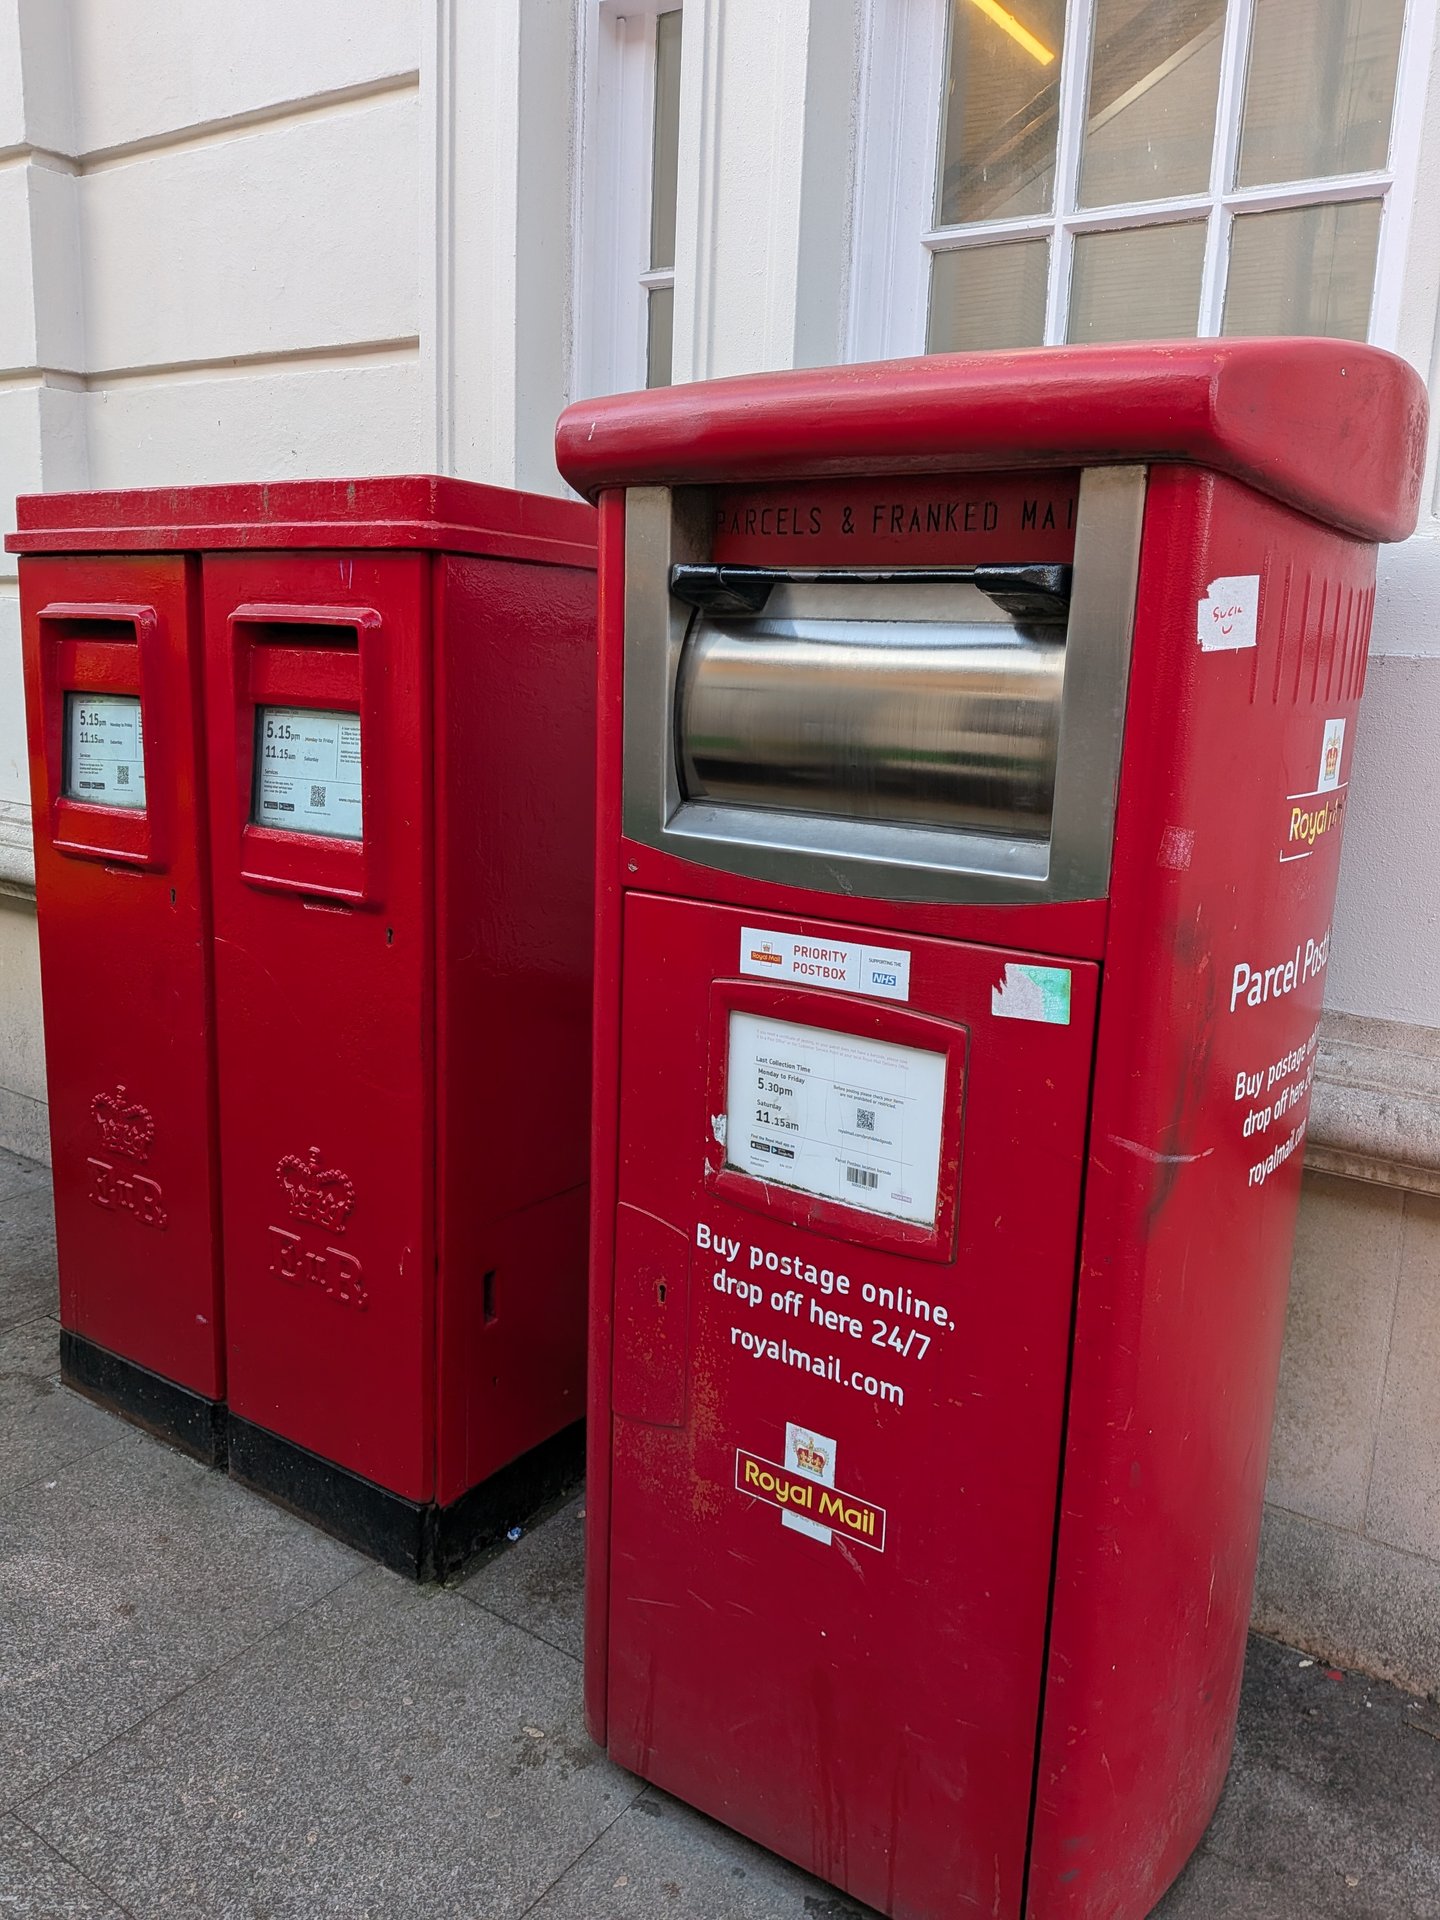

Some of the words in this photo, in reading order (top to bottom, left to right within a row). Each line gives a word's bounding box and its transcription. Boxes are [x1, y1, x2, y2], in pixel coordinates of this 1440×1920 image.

[716, 506, 822, 536] PARCELS
[840, 505, 856, 535] &
[872, 500, 999, 534] FRANKED
[80, 709, 106, 727] 5.15pm
[80, 732, 104, 744] 11.15am
[266, 720, 301, 741] 5.15pm
[265, 744, 296, 760] 11.15am
[793, 944, 847, 964] PRIORITY
[868, 957, 894, 967] SUPPORTING
[793, 961, 846, 981] POSTBOX
[873, 973, 896, 986] NHS
[1230, 944, 1301, 1013] Parcel
[755, 1055, 768, 1064] Last
[768, 1058, 796, 1070] Collection
[797, 1064, 811, 1073] Time
[1234, 1070, 1264, 1102] Buy
[1267, 1043, 1306, 1092] postage
[758, 1067, 779, 1079] Monday
[787, 1074, 806, 1085] Friday
[757, 1077, 793, 1097] 5.30pm
[756, 1099, 782, 1112] Saturday
[853, 1095, 873, 1104] prohibited
[755, 1109, 800, 1131] 11.15am
[1242, 1109, 1271, 1138] drop
[1273, 1088, 1289, 1122] off
[1288, 1084, 1305, 1109] here
[861, 1164, 876, 1172] location
[877, 1168, 892, 1176] barcode
[696, 1222, 741, 1262] Buy
[749, 1245, 850, 1295] postage
[862, 1283, 955, 1331] online,
[712, 1268, 763, 1308] drop
[770, 1290, 804, 1317] off
[809, 1299, 863, 1339] here
[871, 1319, 931, 1361] 24/7
[730, 1326, 905, 1407] royalmail.com
[745, 1460, 813, 1509] Royal
[818, 1491, 875, 1536] Mail
